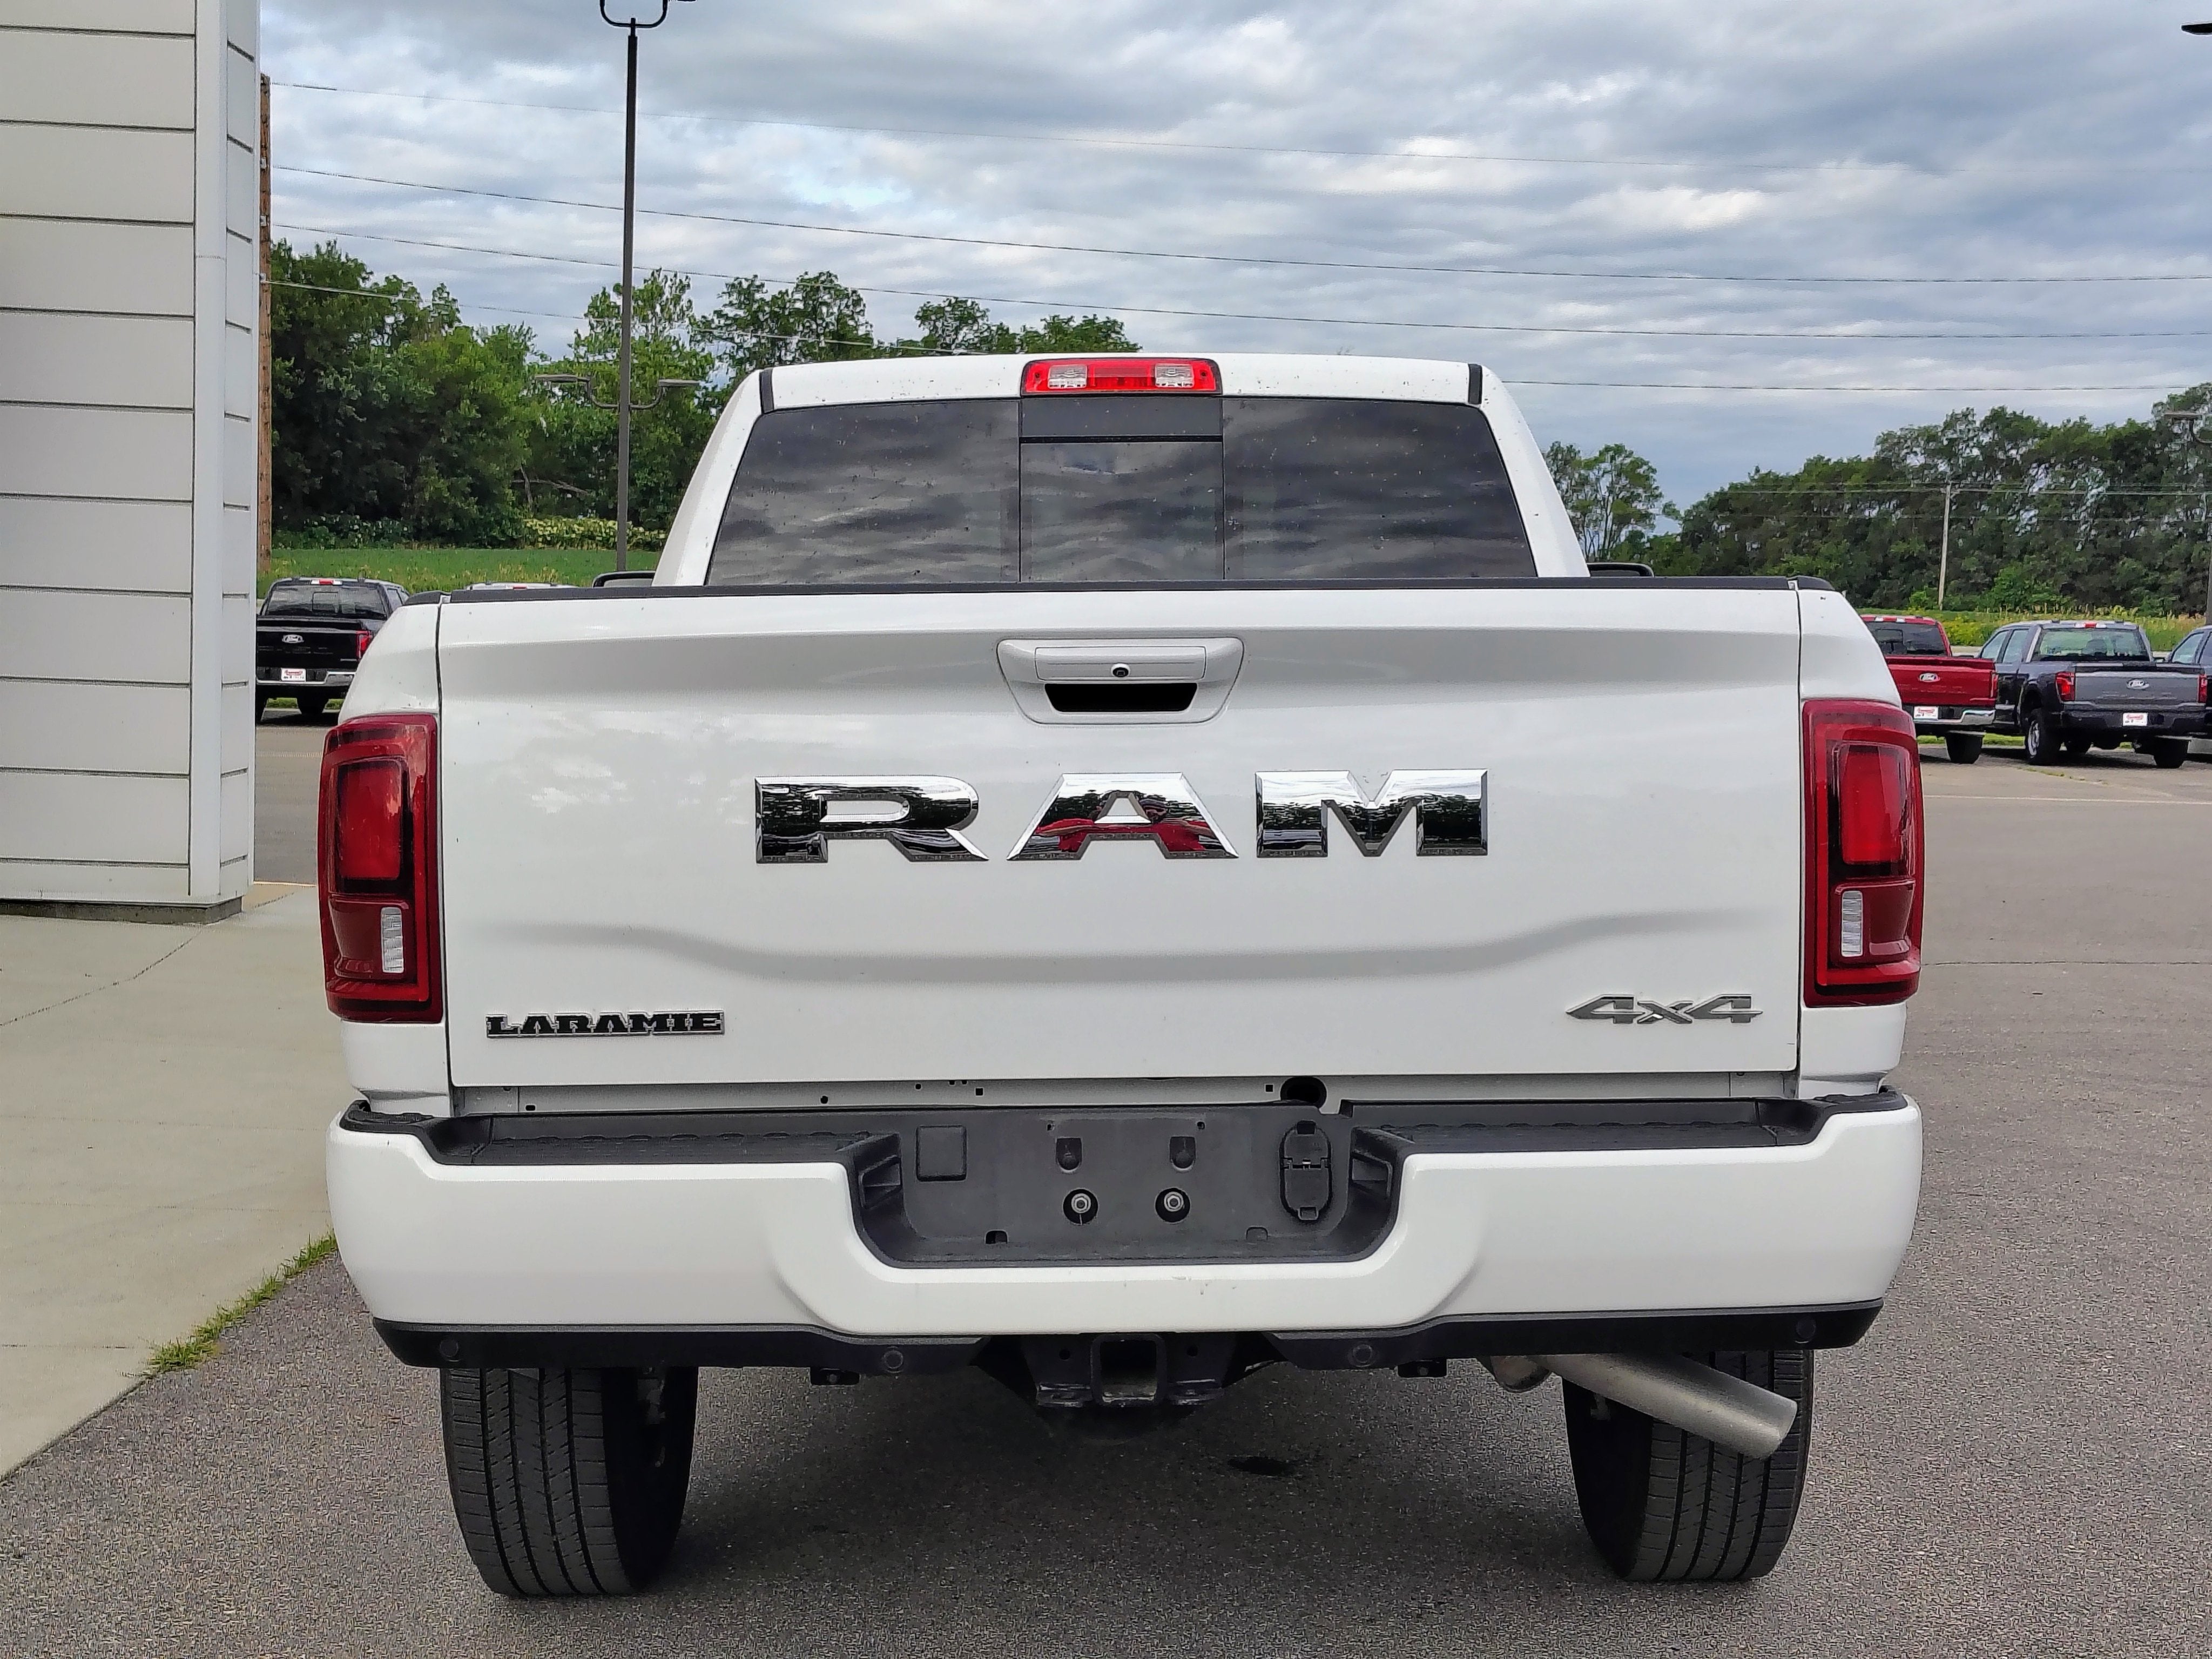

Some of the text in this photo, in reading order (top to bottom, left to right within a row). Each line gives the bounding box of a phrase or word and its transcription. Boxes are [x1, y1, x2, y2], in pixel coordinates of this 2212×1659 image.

[755, 768, 1489, 864] RAM
[485, 1010, 724, 1037] LARAMIE
[1566, 994, 1763, 1024] 4x4
